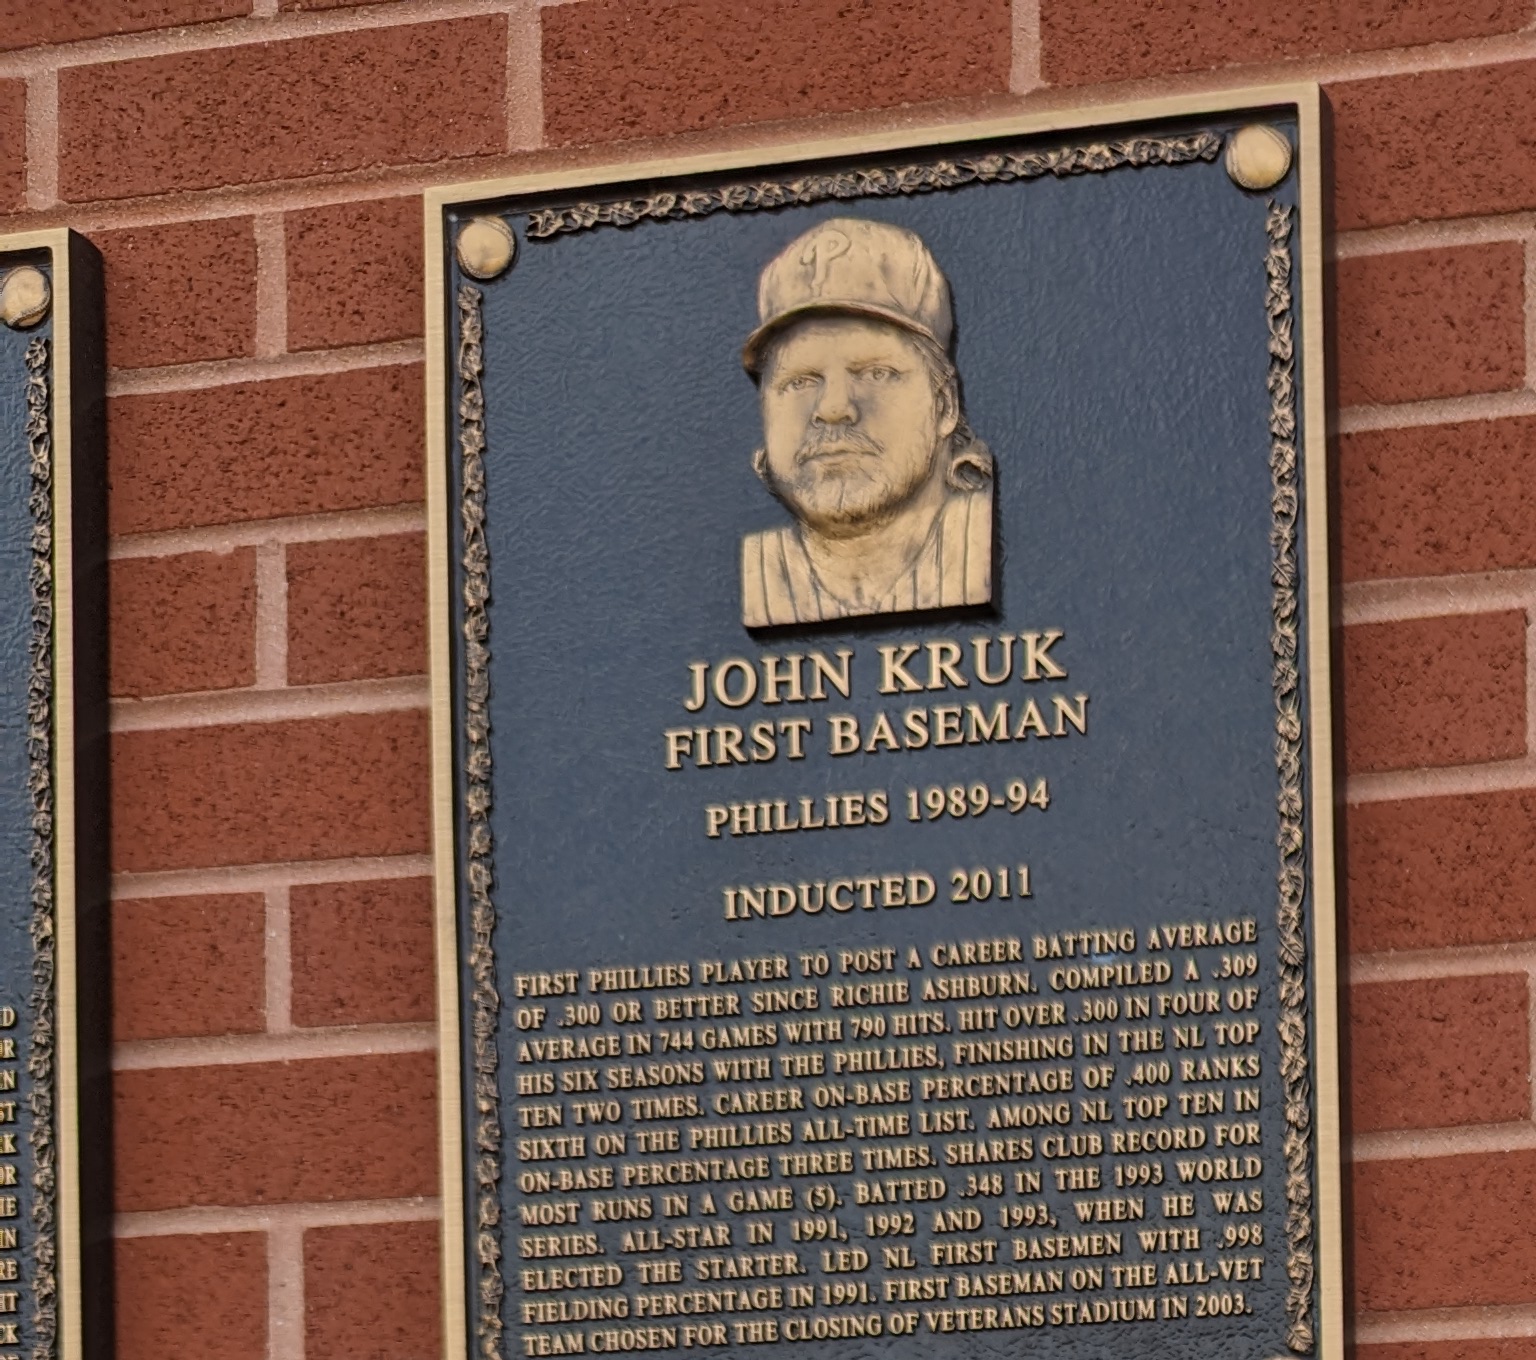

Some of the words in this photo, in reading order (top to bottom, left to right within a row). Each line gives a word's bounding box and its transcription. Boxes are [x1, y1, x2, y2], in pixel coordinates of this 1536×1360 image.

[684, 649, 853, 711] JOHN
[878, 629, 1067, 693] KRUK
[664, 718, 811, 769] FIRST
[828, 693, 1088, 754] BASEMAN
[704, 789, 889, 837] PHILLIES
[907, 778, 1049, 820] 1989-94
[723, 871, 936, 919] INDUCTED
[951, 865, 1029, 901] 2011
[512, 969, 579, 997] FIRST
[586, 962, 690, 992] PHILLIES
[697, 954, 789, 984] PLAYER
[797, 950, 829, 976] TO
[837, 945, 896, 973] POST
[907, 946, 921, 968] A
[929, 935, 1022, 966] CAREER
[1031, 927, 1135, 959] BATTING
[1146, 917, 1256, 950] AVERAGE
[514, 1070, 555, 1095] HIS
[558, 1066, 599, 1092] SIX
[603, 1059, 704, 1088] SEASONS
[709, 1054, 770, 1080] WITH
[777, 1050, 825, 1077] THE
[830, 1042, 945, 1073] PHILLIES,
[950, 1032, 1073, 1064] FINISHING
[1080, 1030, 1108, 1055] IN
[1117, 1025, 1164, 1052] THE
[1171, 1023, 1205, 1048] NL
[1212, 1018, 1259, 1045] TOP
[516, 1164, 613, 1193] ON-BASE
[619, 1153, 769, 1186] PERCENTAGE
[776, 1147, 853, 1176] THREE
[859, 1143, 937, 1170] TIMES.
[943, 1136, 1033, 1165] SHARES
[1039, 1131, 1103, 1158] CLUB
[1109, 1124, 1206, 1153] RECORD
[1212, 1119, 1260, 1146] FOR
[519, 1330, 584, 1356] TEAM
[587, 1325, 676, 1352] CHOSEN
[679, 1321, 727, 1347] FOR
[731, 1318, 779, 1343] THE
[781, 1312, 882, 1340] CLOSING
[886, 1310, 919, 1334] OF
[922, 1303, 1045, 1331] VETERANS
[1048, 1295, 1155, 1325] STADIUM
[1160, 1294, 1188, 1318] IN
[1194, 1289, 1252, 1316] 2003.
